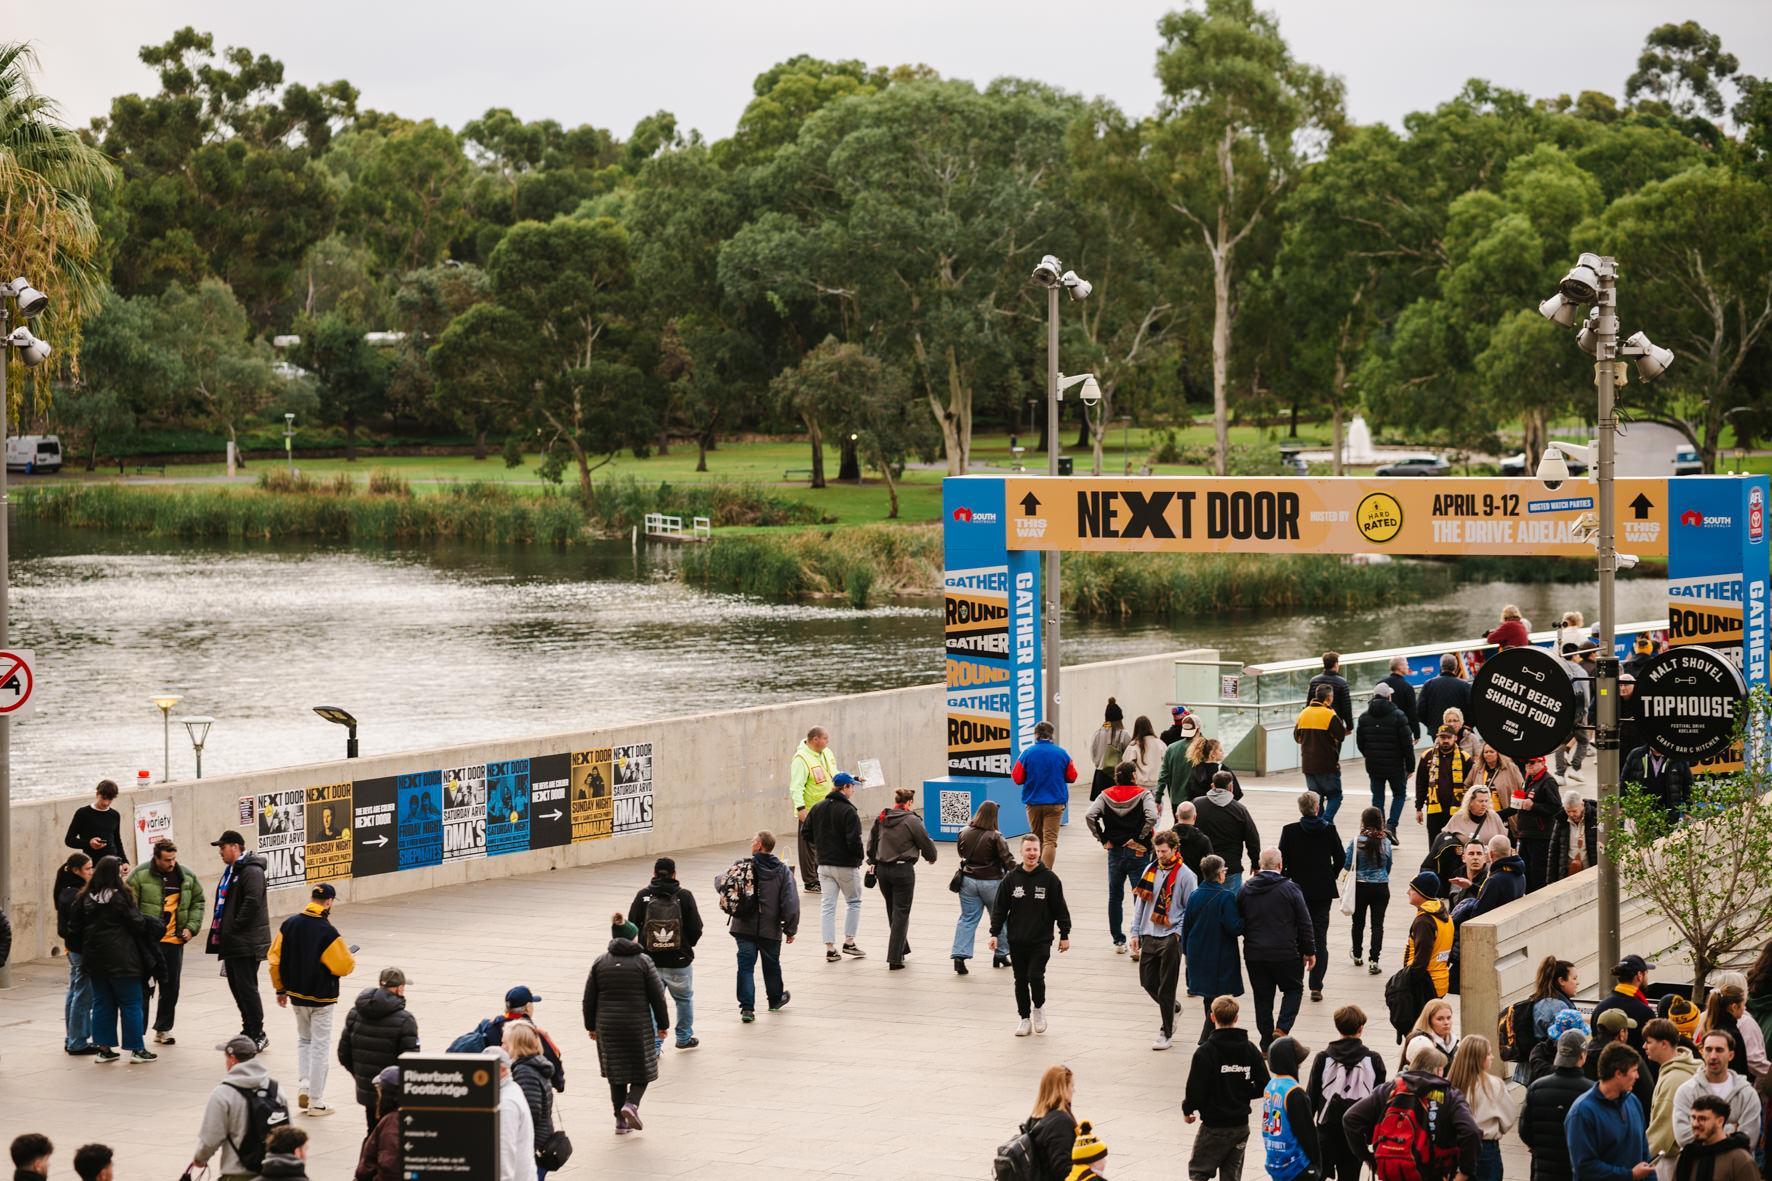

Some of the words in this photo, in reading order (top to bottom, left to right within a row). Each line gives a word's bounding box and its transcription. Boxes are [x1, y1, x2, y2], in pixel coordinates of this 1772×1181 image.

[1432, 494, 1479, 516] APRIL
[1483, 494, 1520, 517] 9-12
[1551, 501, 1569, 510] WATCH
[1569, 499, 1591, 509] PARTIES
[1014, 519, 1047, 528] THIS
[1077, 491, 1196, 539] NEXT
[1207, 491, 1300, 540] DOOR
[1310, 511, 1334, 522] HOSTED
[1336, 511, 1349, 522] BY
[1364, 517, 1398, 531] RATED
[1368, 511, 1390, 520] HARD
[1703, 516, 1731, 524] SOUTH
[1016, 528, 1045, 538] WAY
[1432, 520, 1461, 543] THE
[1465, 520, 1513, 543] DRIVE
[1623, 522, 1660, 532] THIS
[1625, 532, 1658, 542] WAY
[945, 572, 1008, 592] GATHER
[1668, 580, 1743, 602] GATHER
[945, 597, 1008, 626] ROUND
[1016, 572, 1034, 664] GATHER
[1669, 607, 1743, 639] ROUND
[1750, 580, 1764, 681] GATHER
[946, 632, 1009, 654] GATHER
[946, 659, 1010, 687] ROUND
[1649, 658, 1678, 682] MALT
[1682, 657, 1725, 683] SHOVEL
[1490, 673, 1527, 696] GREAT
[1526, 688, 1563, 713] BEERS
[947, 693, 1010, 713] GATHER
[1017, 668, 1036, 752] ROUND
[1485, 688, 1527, 715] SHARED
[1527, 707, 1557, 728] FOOD
[1640, 696, 1734, 718] TAPHOUSE
[948, 717, 1010, 746] ROUND
[1502, 724, 1518, 735] STAIRS
[1505, 719, 1519, 729] DOWN
[613, 746, 634, 760] NEXT
[636, 743, 652, 757] DOOR
[1656, 734, 1675, 749] CRAFT
[1696, 735, 1720, 753] KITCHEN
[573, 751, 593, 765] NEXT
[595, 748, 612, 762] DOOR
[948, 753, 1012, 775] GATHER
[443, 768, 466, 783] NEXT
[468, 765, 485, 780] DOOR
[487, 762, 510, 777] NEXT
[511, 760, 528, 774] DOOR
[399, 774, 421, 789] NEXT
[423, 771, 441, 785] DOOR
[306, 787, 331, 802] NEXT
[332, 784, 351, 798] DOOR
[532, 790, 549, 803] NEXT
[550, 788, 565, 800] DOOR
[614, 784, 638, 797] SATURDAY
[640, 782, 652, 793] ARVO
[258, 793, 284, 809] NEXT
[284, 790, 304, 806] DOOR
[573, 800, 594, 814] SUNDAY
[596, 798, 612, 810] NIGHT
[444, 808, 470, 821] SATURDAY
[471, 805, 485, 817] ARVO
[613, 795, 652, 826] DMA'S
[147, 815, 170, 828] variety
[355, 815, 374, 829] NEXT
[375, 813, 391, 826] DOOR
[399, 821, 420, 838] FRIDAY
[422, 819, 442, 834] NIGHT
[487, 823, 512, 835] SATURDAY
[259, 835, 287, 848] SATURDAY
[289, 832, 304, 843] ARVO
[444, 819, 486, 852] DMA'S
[307, 843, 334, 857] THURSDAY
[335, 840, 351, 852] NIGHT
[403, 1069, 464, 1083] Riverbank
[403, 1083, 469, 1098] Footbridge
